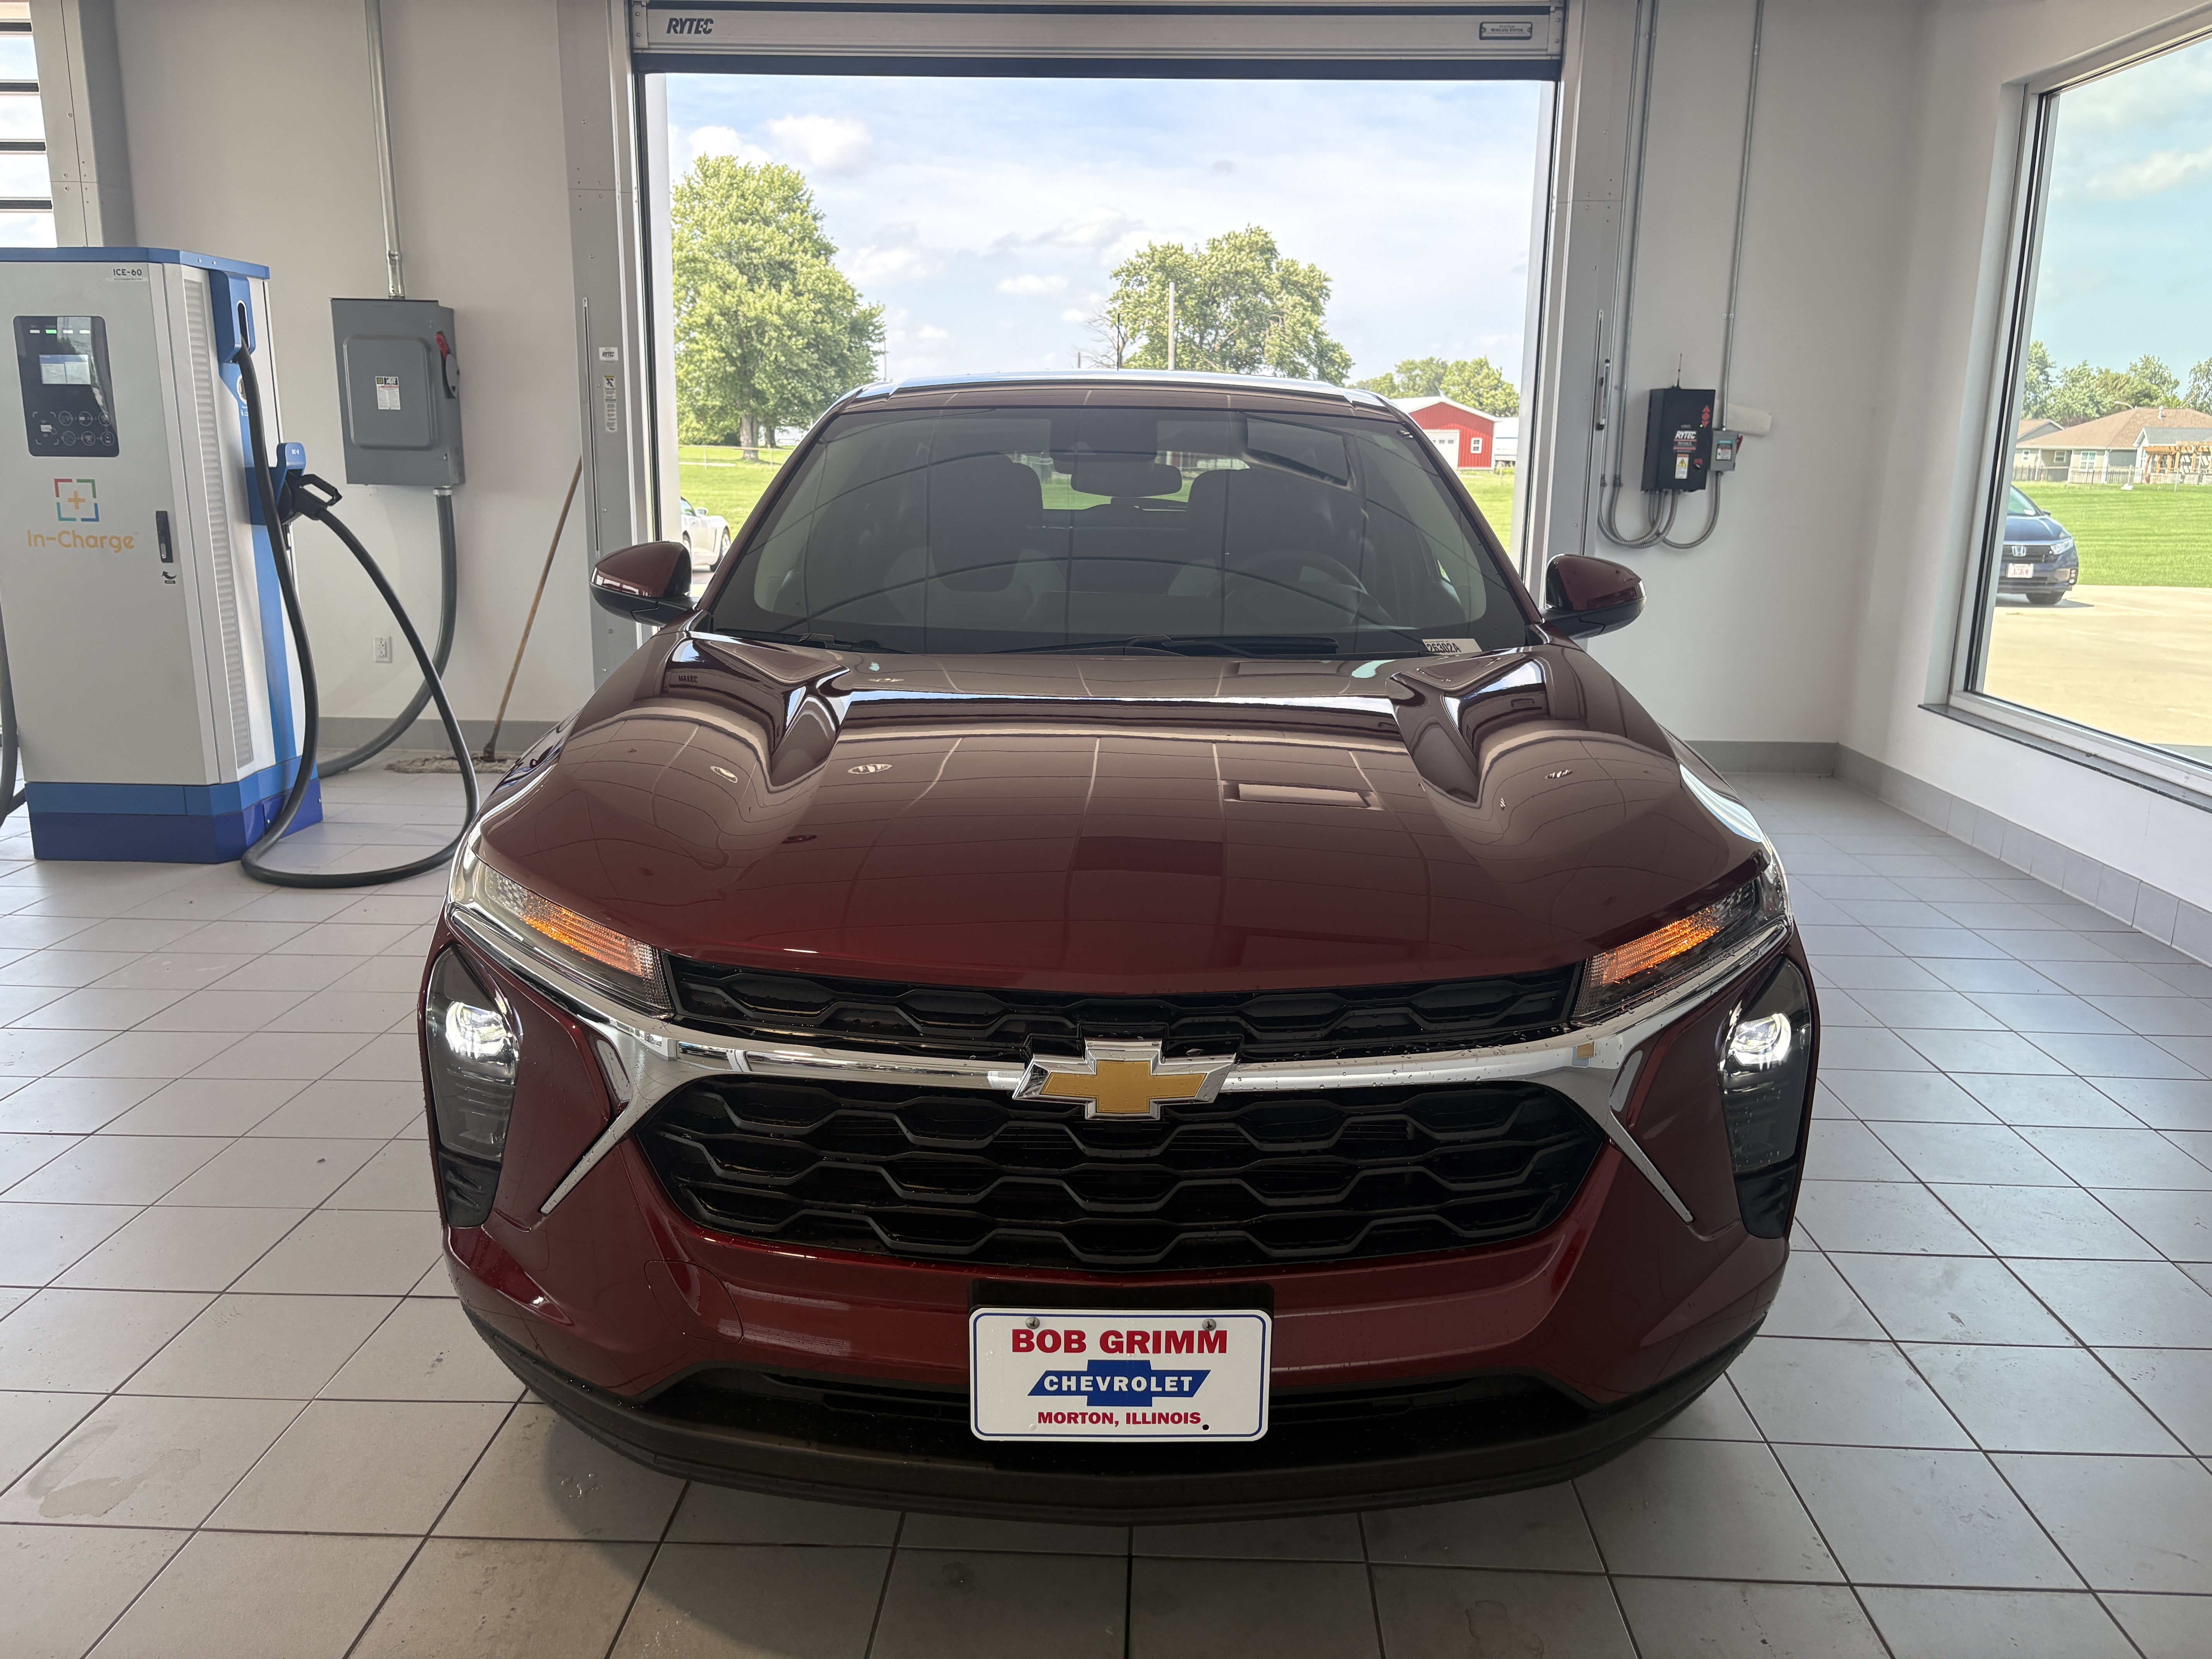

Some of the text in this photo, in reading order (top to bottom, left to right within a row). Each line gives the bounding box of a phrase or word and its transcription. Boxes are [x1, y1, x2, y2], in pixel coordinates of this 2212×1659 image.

[666, 18, 714, 34] RYTEC
[1675, 430, 1696, 439] RYTEC
[1426, 642, 1462, 653] 26302A
[1012, 1329, 1227, 1354] BOB GRIMM
[1044, 1375, 1193, 1392] CHEVROLET
[1037, 1412, 1201, 1427] MORTON, ILLINOIS
